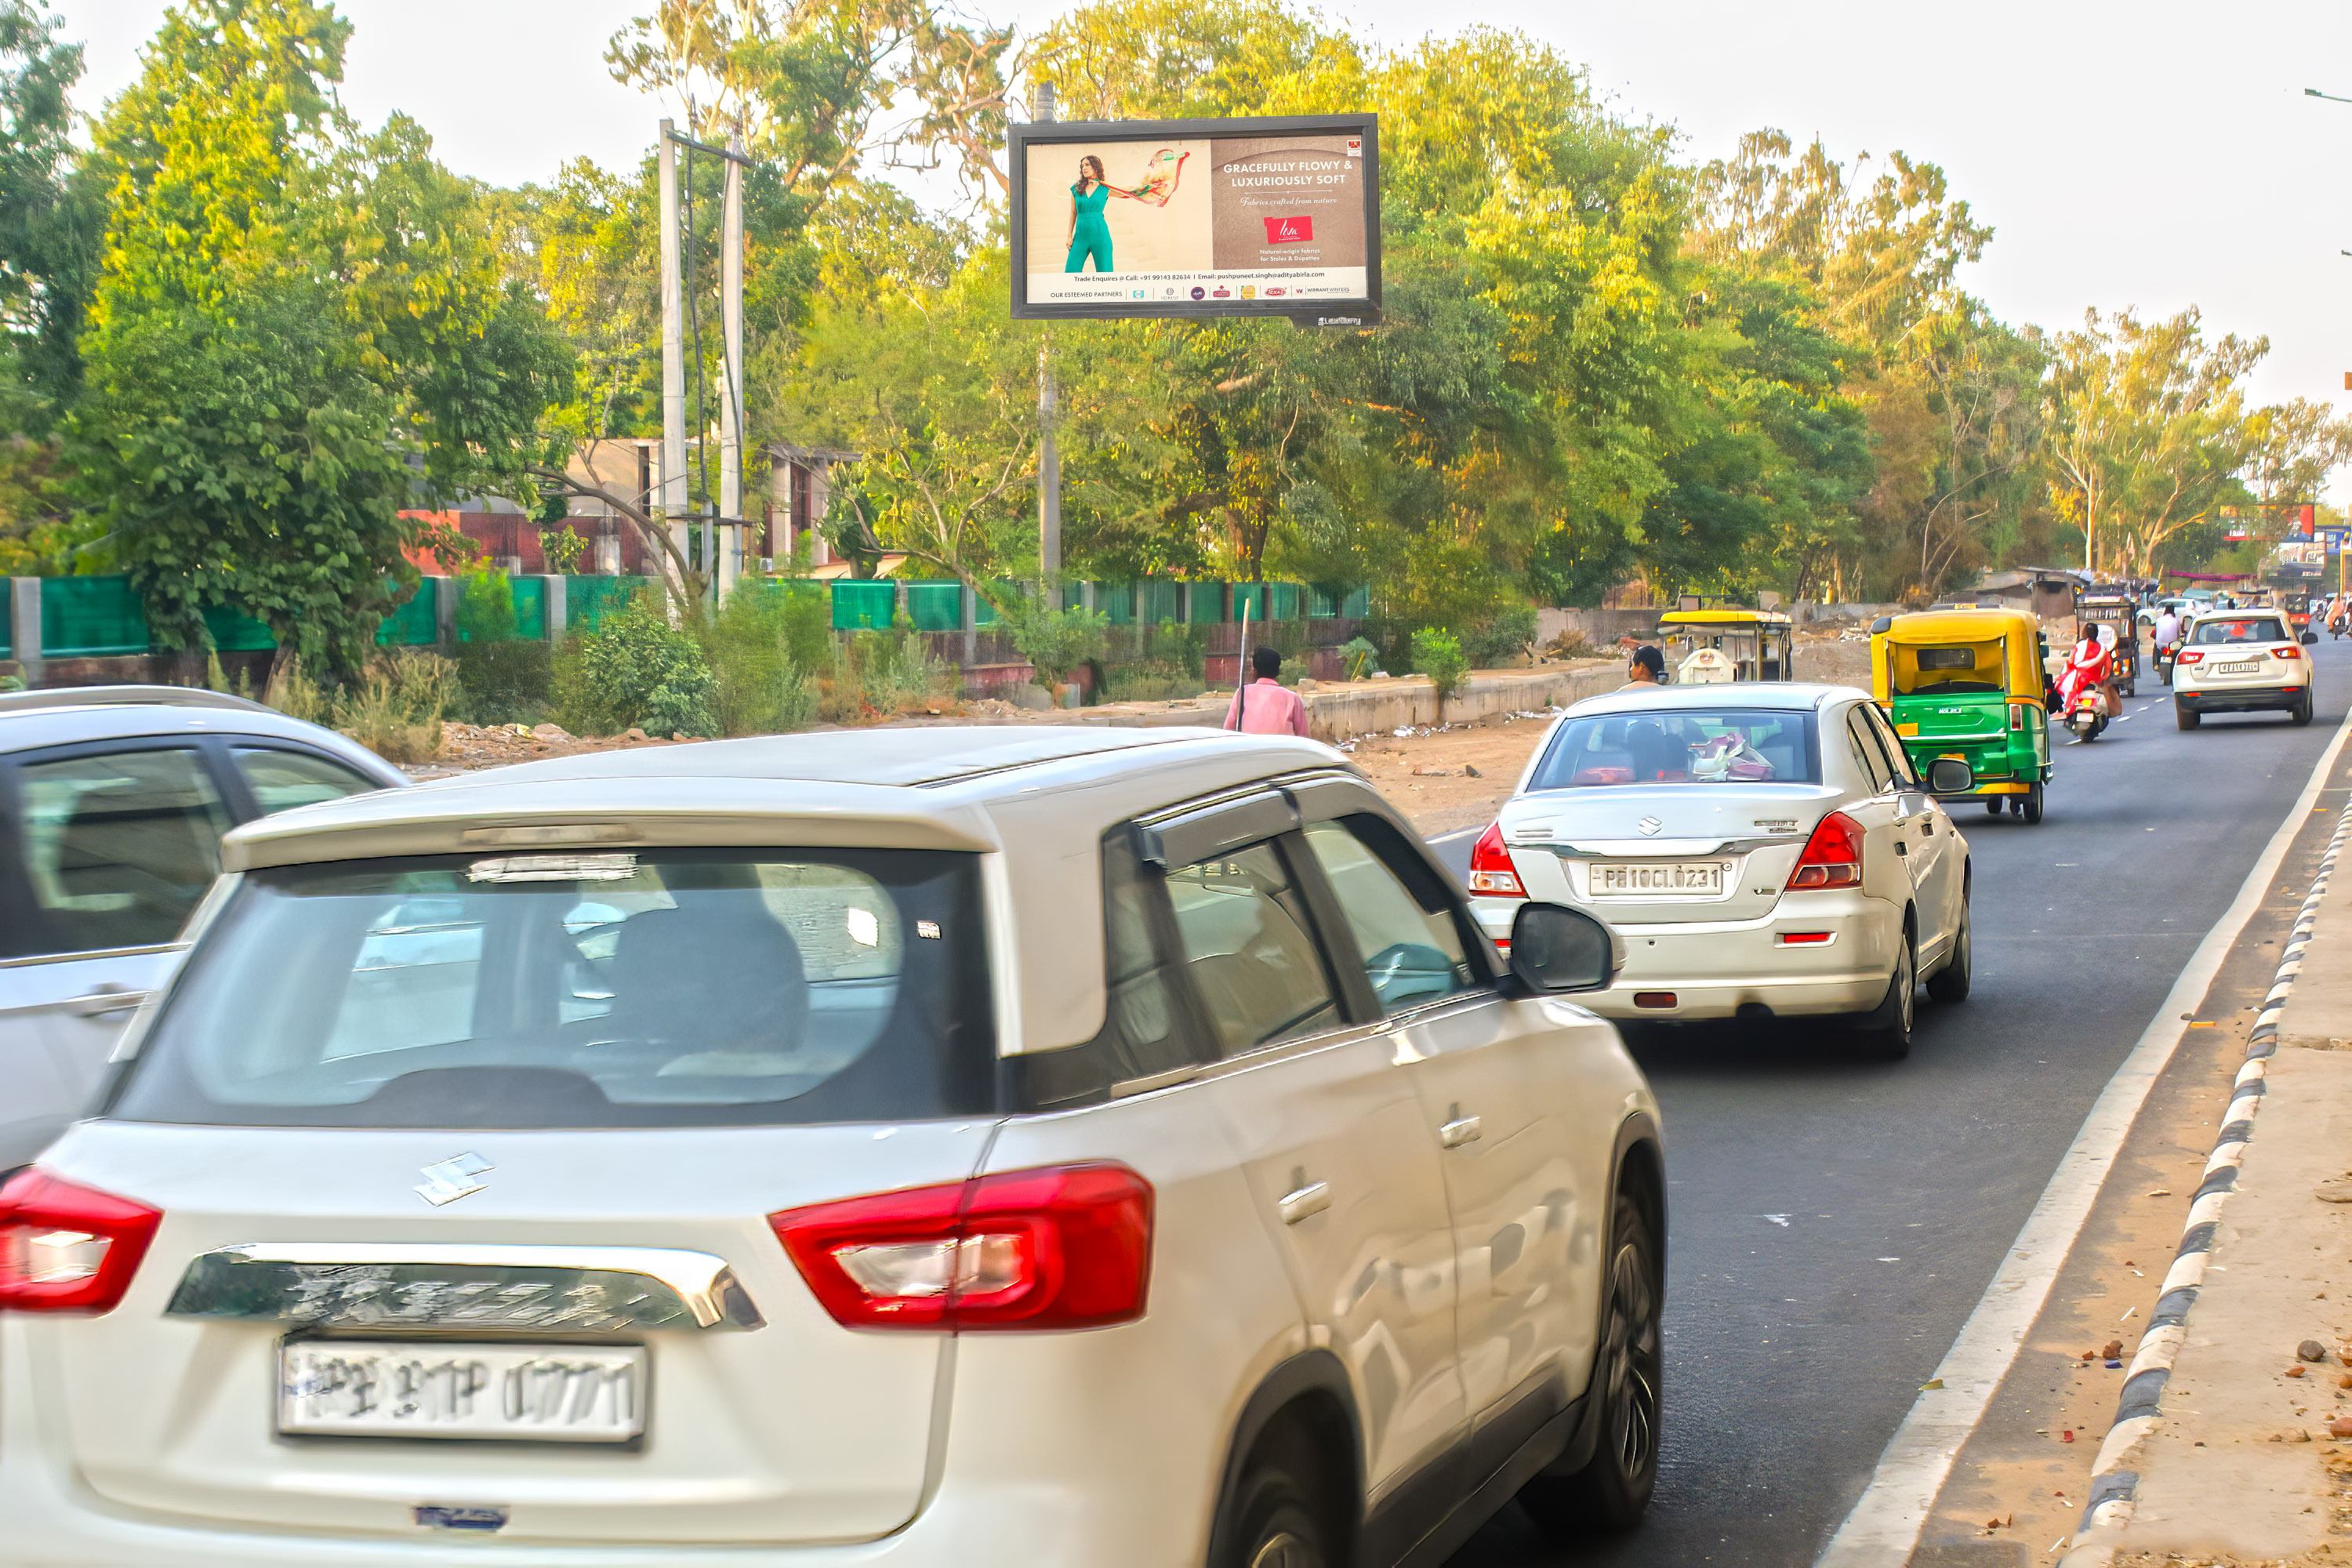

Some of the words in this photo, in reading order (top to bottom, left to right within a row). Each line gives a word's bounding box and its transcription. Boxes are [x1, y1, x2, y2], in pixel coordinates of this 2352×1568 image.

[1223, 162, 1295, 174] GRACEFULLY
[1299, 161, 1341, 172] FLOWY
[1344, 160, 1353, 170] &
[1231, 176, 1313, 187] LUXURIOUSLY
[1316, 174, 1346, 185] SOFT
[1240, 197, 1269, 207] Fabrics
[1269, 197, 1294, 206] crafted
[1294, 197, 1312, 207] from
